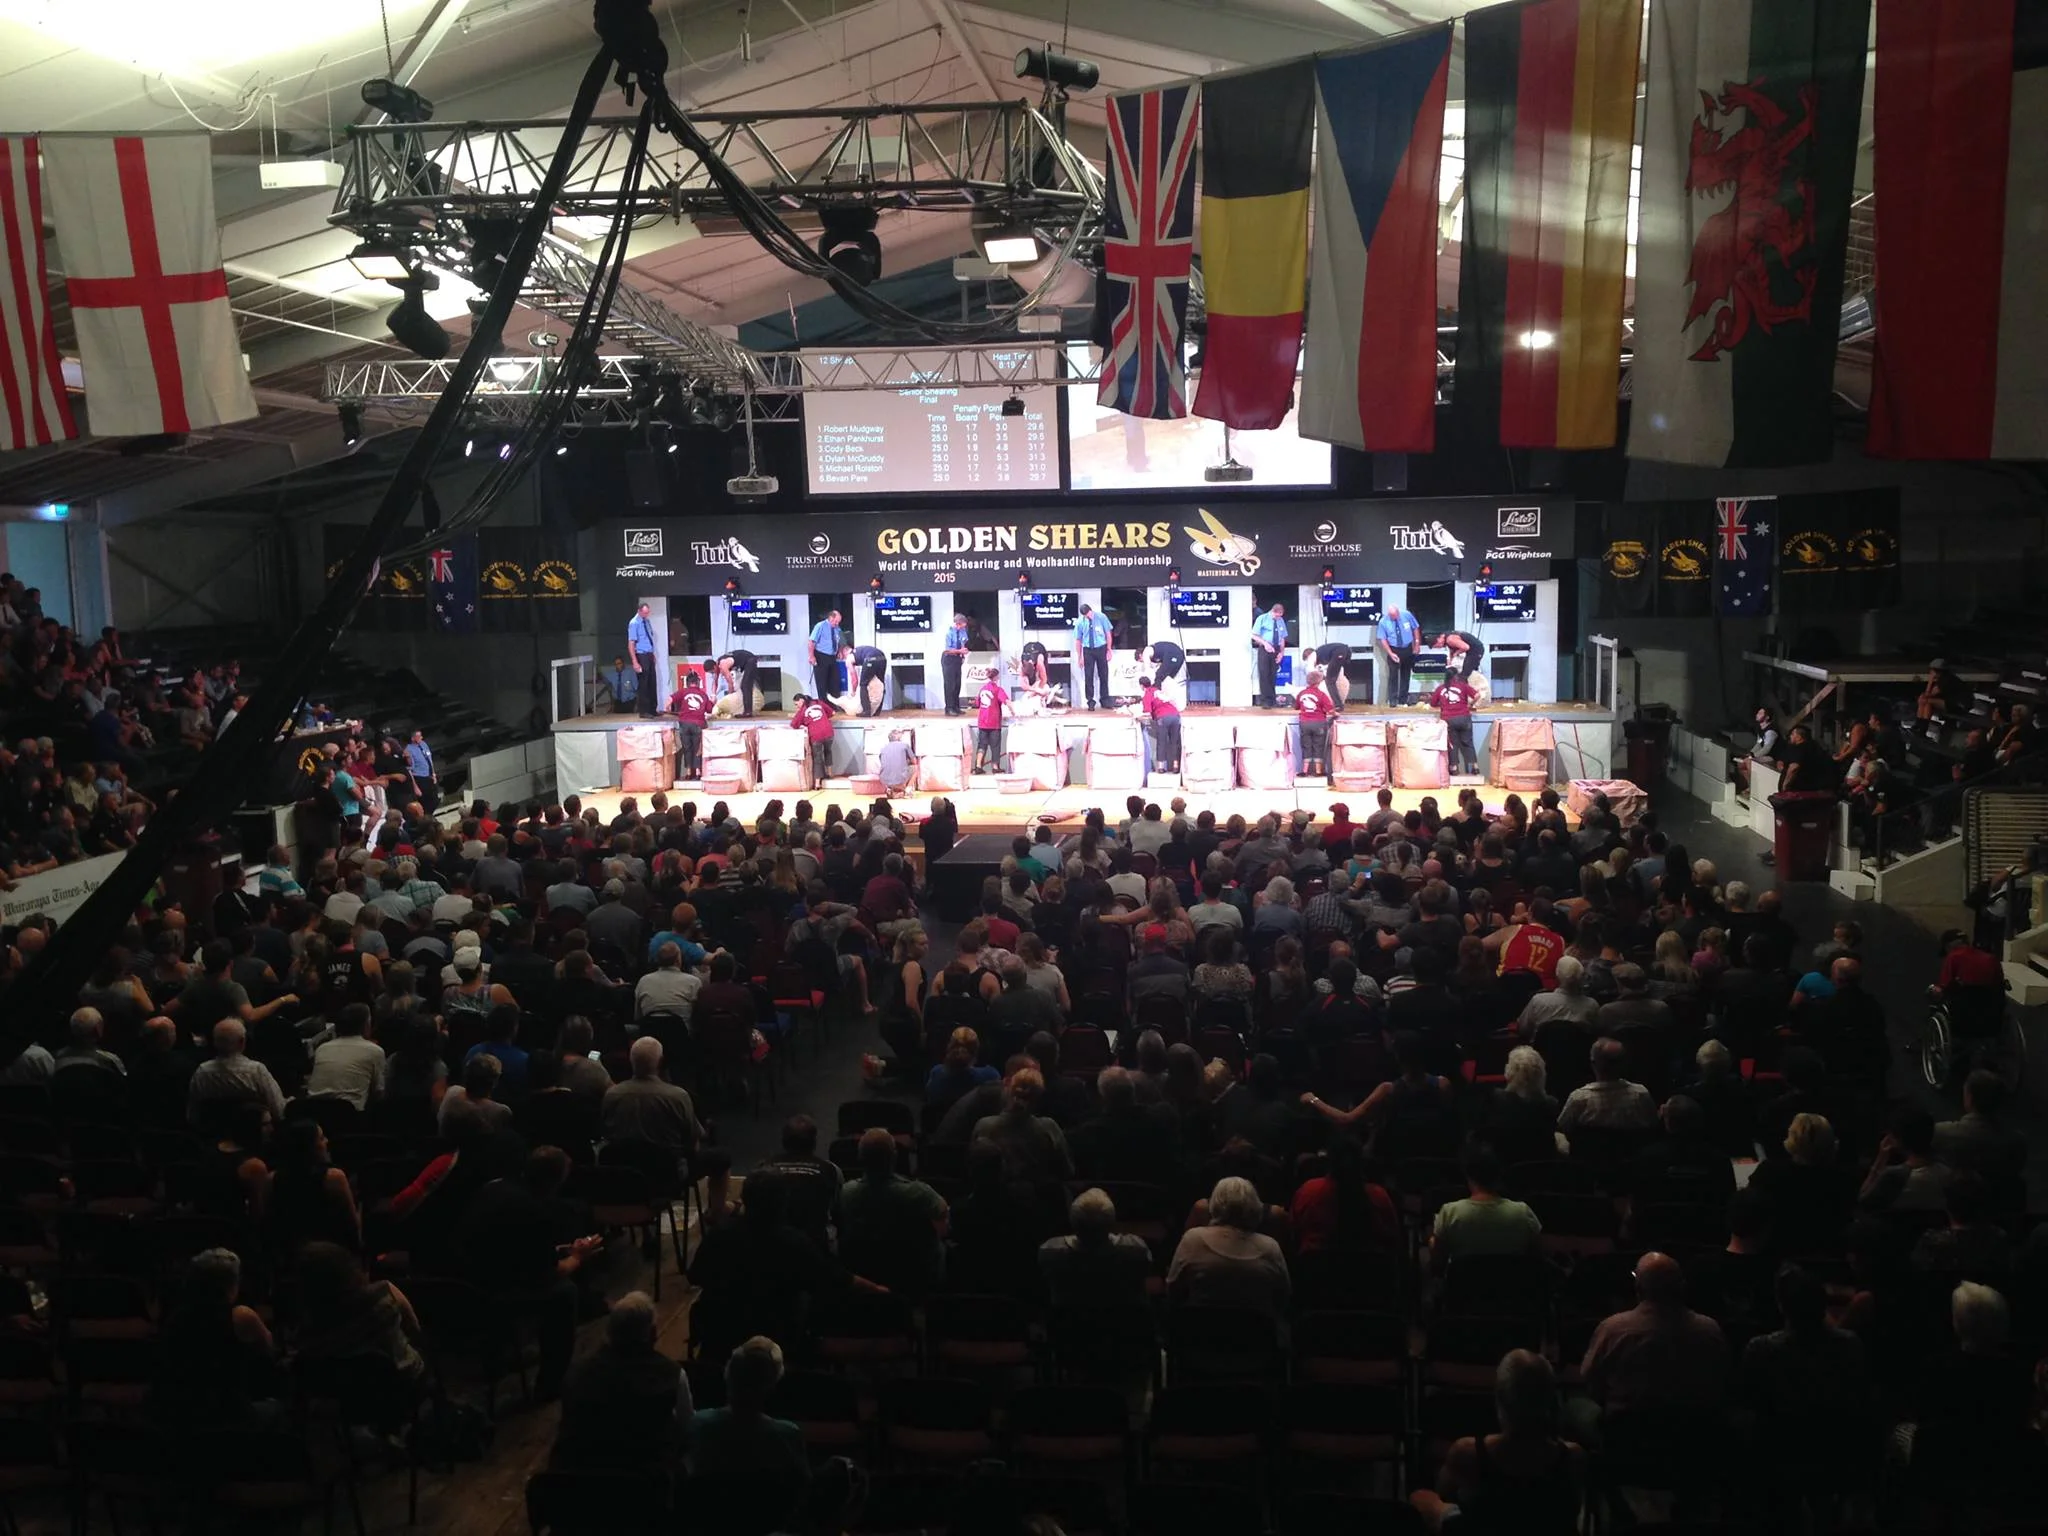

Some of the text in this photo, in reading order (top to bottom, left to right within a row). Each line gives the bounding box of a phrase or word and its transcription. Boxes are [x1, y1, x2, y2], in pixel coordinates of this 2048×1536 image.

[919, 395, 938, 404] Final
[953, 404, 981, 414] Penalty
[927, 413, 946, 422] Time
[955, 413, 979, 421] Board
[1501, 511, 1537, 527] Lister
[628, 532, 659, 547] Lister
[877, 522, 1171, 555] GOLDEN SHEARS
[1390, 523, 1433, 550] Tui
[691, 539, 731, 565] Tui
[1288, 543, 1362, 553] TRUST HOUSE
[785, 555, 854, 564] TRUST HOUSE
[1486, 550, 1552, 560] PGG Wrightson
[878, 554, 1172, 571] World Premier Shearing and Woolhandling Championship
[481, 562, 504, 582] GOLDEN
[532, 562, 555, 582] GOLDEN
[616, 569, 675, 578] PGG Wrightson
[934, 572, 956, 583] 2015
[1350, 589, 1370, 598] 31.0
[1503, 585, 1524, 595] 29.7
[1048, 594, 1067, 603] 31.7
[1197, 592, 1217, 601] 31.3
[757, 600, 775, 609] 29.6
[1528, 943, 1549, 972] 12
